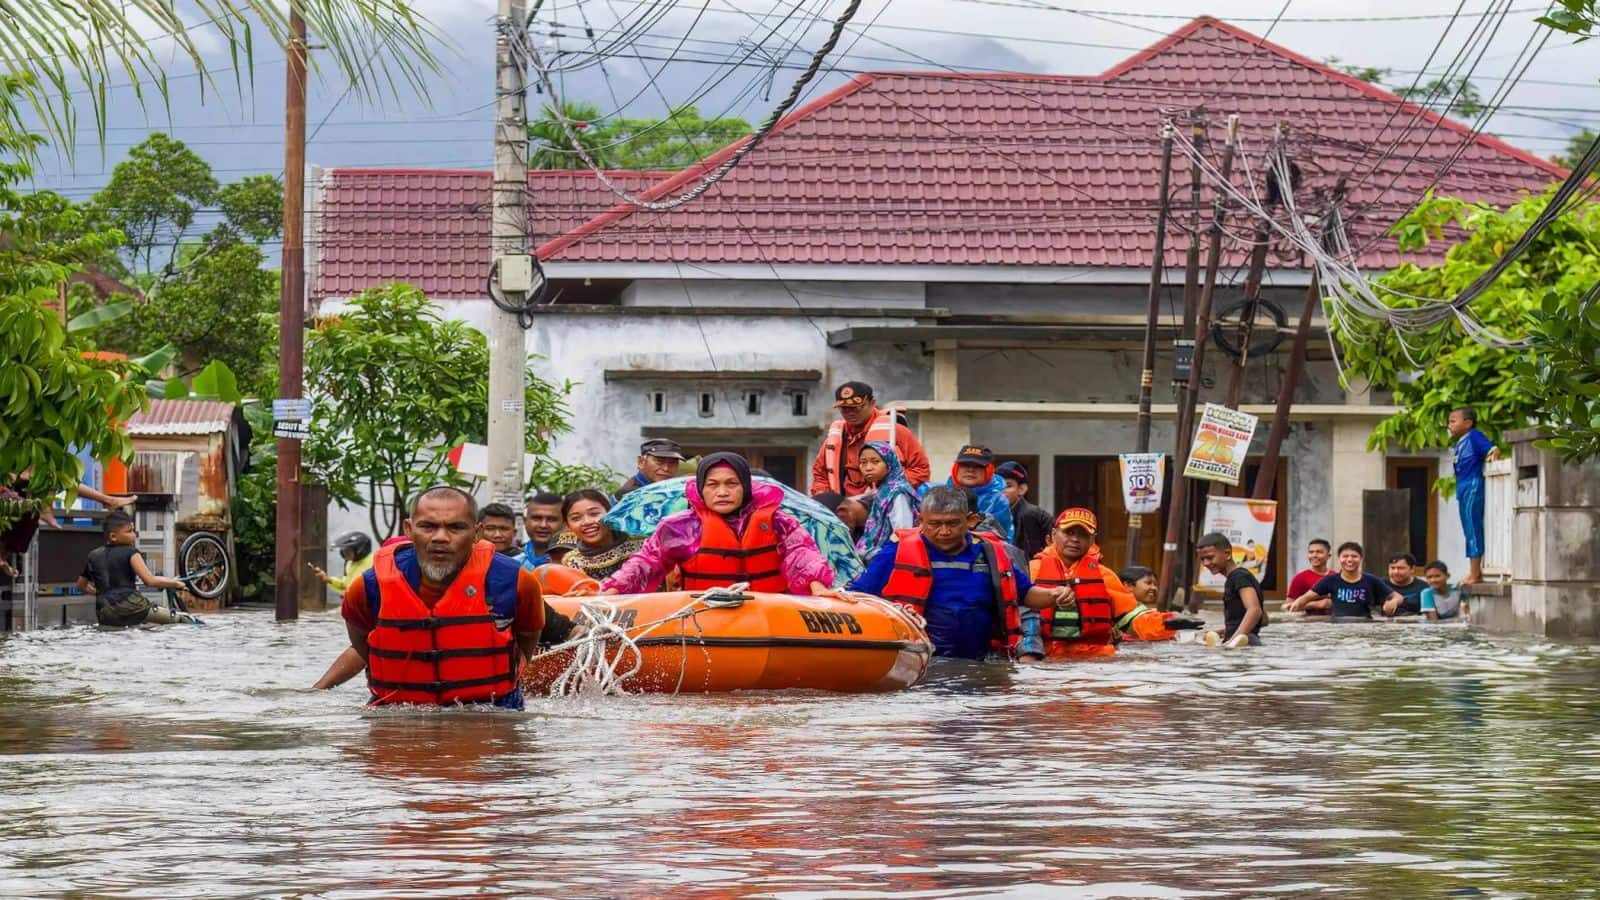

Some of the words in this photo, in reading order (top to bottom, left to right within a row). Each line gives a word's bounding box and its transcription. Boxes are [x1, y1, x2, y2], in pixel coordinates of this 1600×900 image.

[1192, 430, 1236, 464] 25
[1338, 588, 1366, 602] HOPE
[799, 610, 863, 635] BNPB
